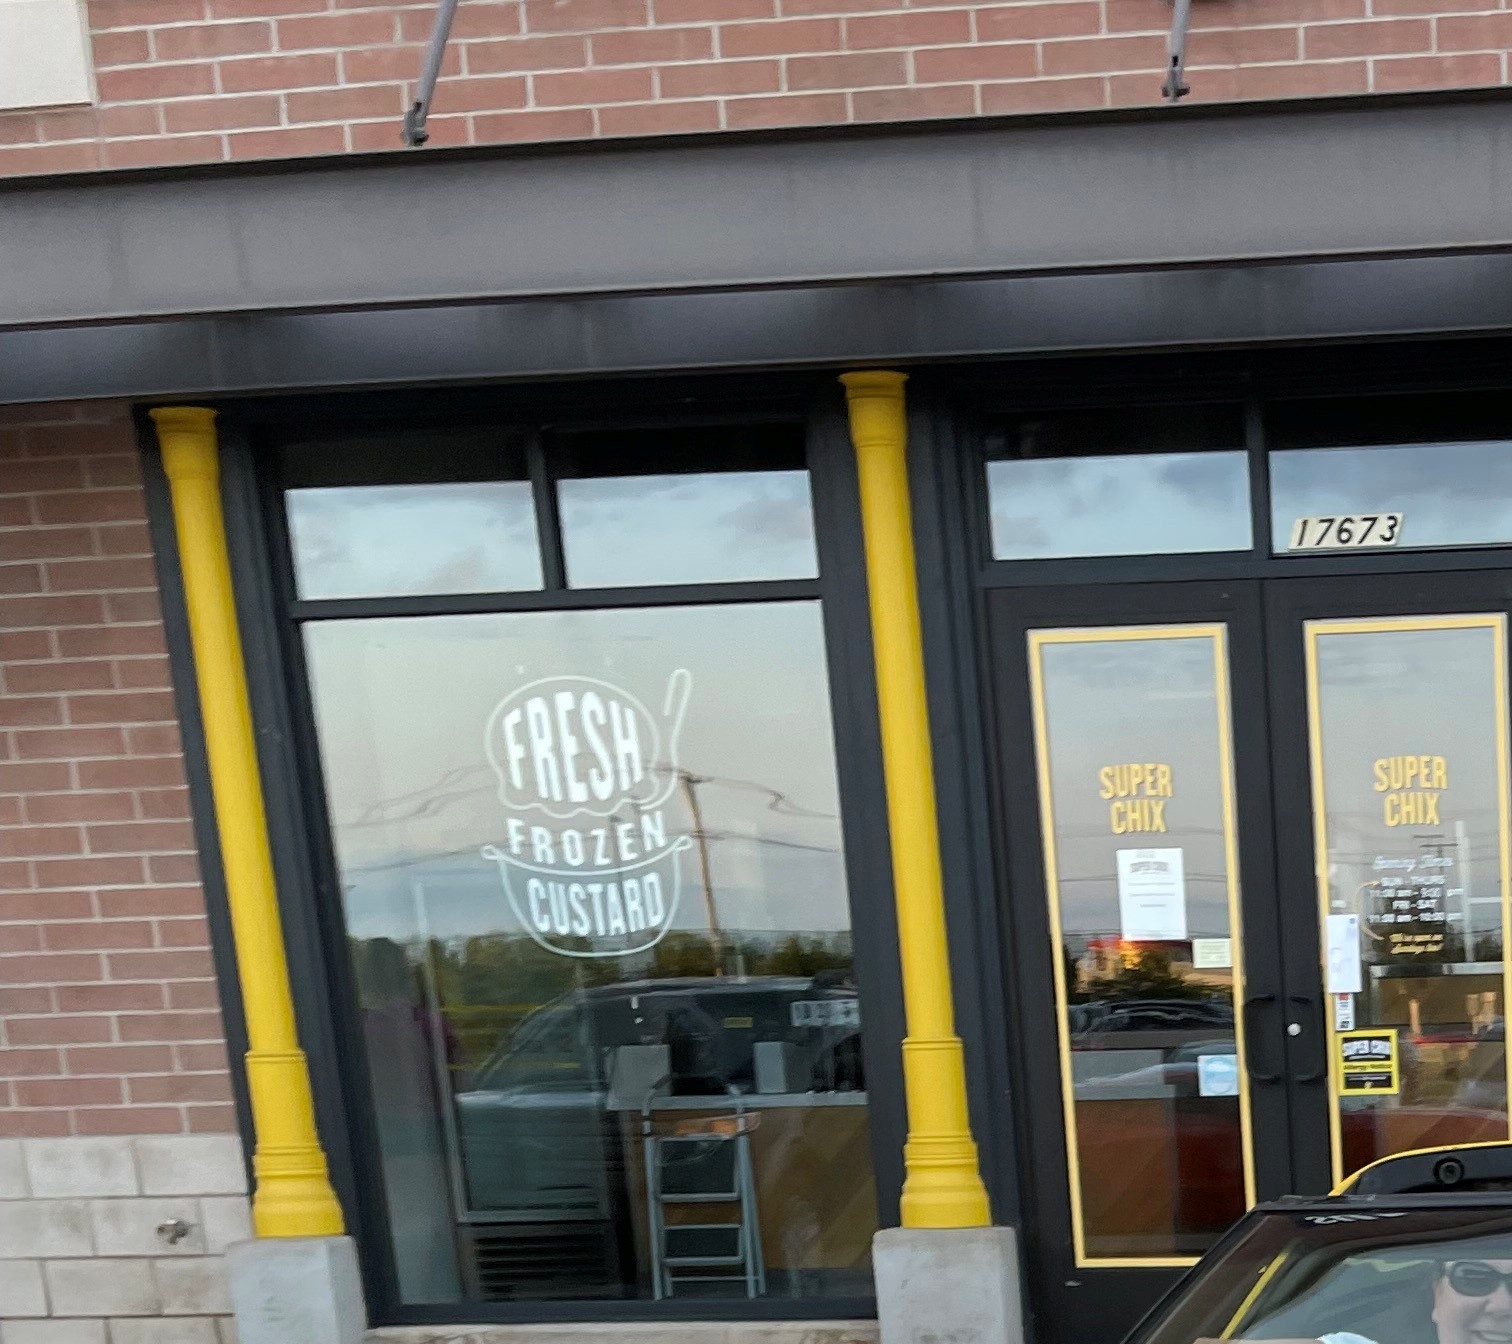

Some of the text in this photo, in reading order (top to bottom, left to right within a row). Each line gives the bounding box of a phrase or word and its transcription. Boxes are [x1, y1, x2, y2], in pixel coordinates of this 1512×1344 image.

[1297, 515, 1398, 546] 17673
[502, 690, 644, 803] FRESH
[1099, 762, 1173, 800] SUPER
[1373, 754, 1448, 792] SUPER
[1110, 799, 1167, 835] CHIX
[1384, 791, 1441, 827] CHIX
[506, 810, 668, 867] FROZEN
[526, 871, 666, 937] CUSTARD
